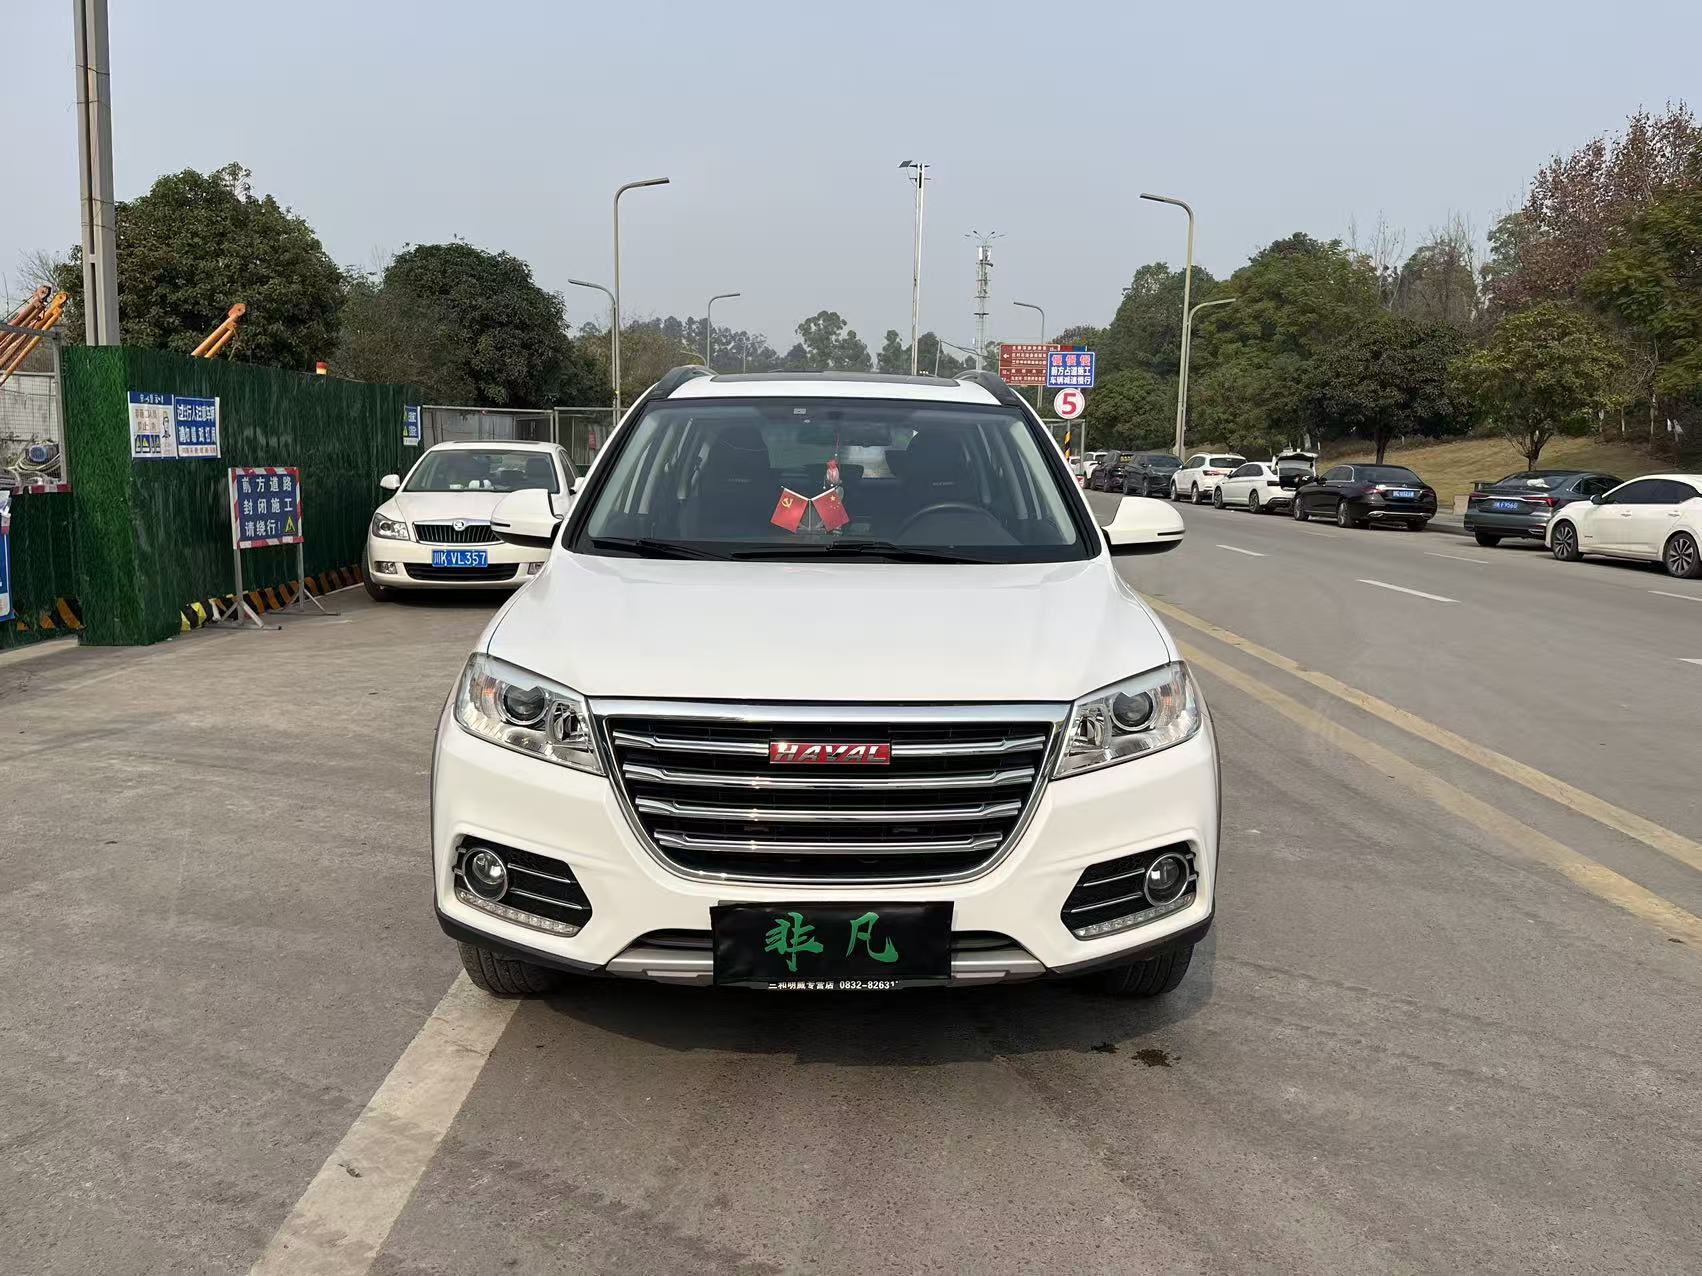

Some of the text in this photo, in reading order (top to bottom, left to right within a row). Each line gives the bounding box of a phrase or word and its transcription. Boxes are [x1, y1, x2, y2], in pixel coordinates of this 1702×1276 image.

[1050, 366, 1091, 376] 前方占道施工
[1050, 376, 1091, 385] 车辆减速慢行
[1061, 392, 1077, 415] 5
[241, 475, 292, 494] 前方道路
[243, 497, 294, 515] 封闭施工
[774, 744, 887, 762] HAVAL
[839, 981, 899, 990] 0832-82631
